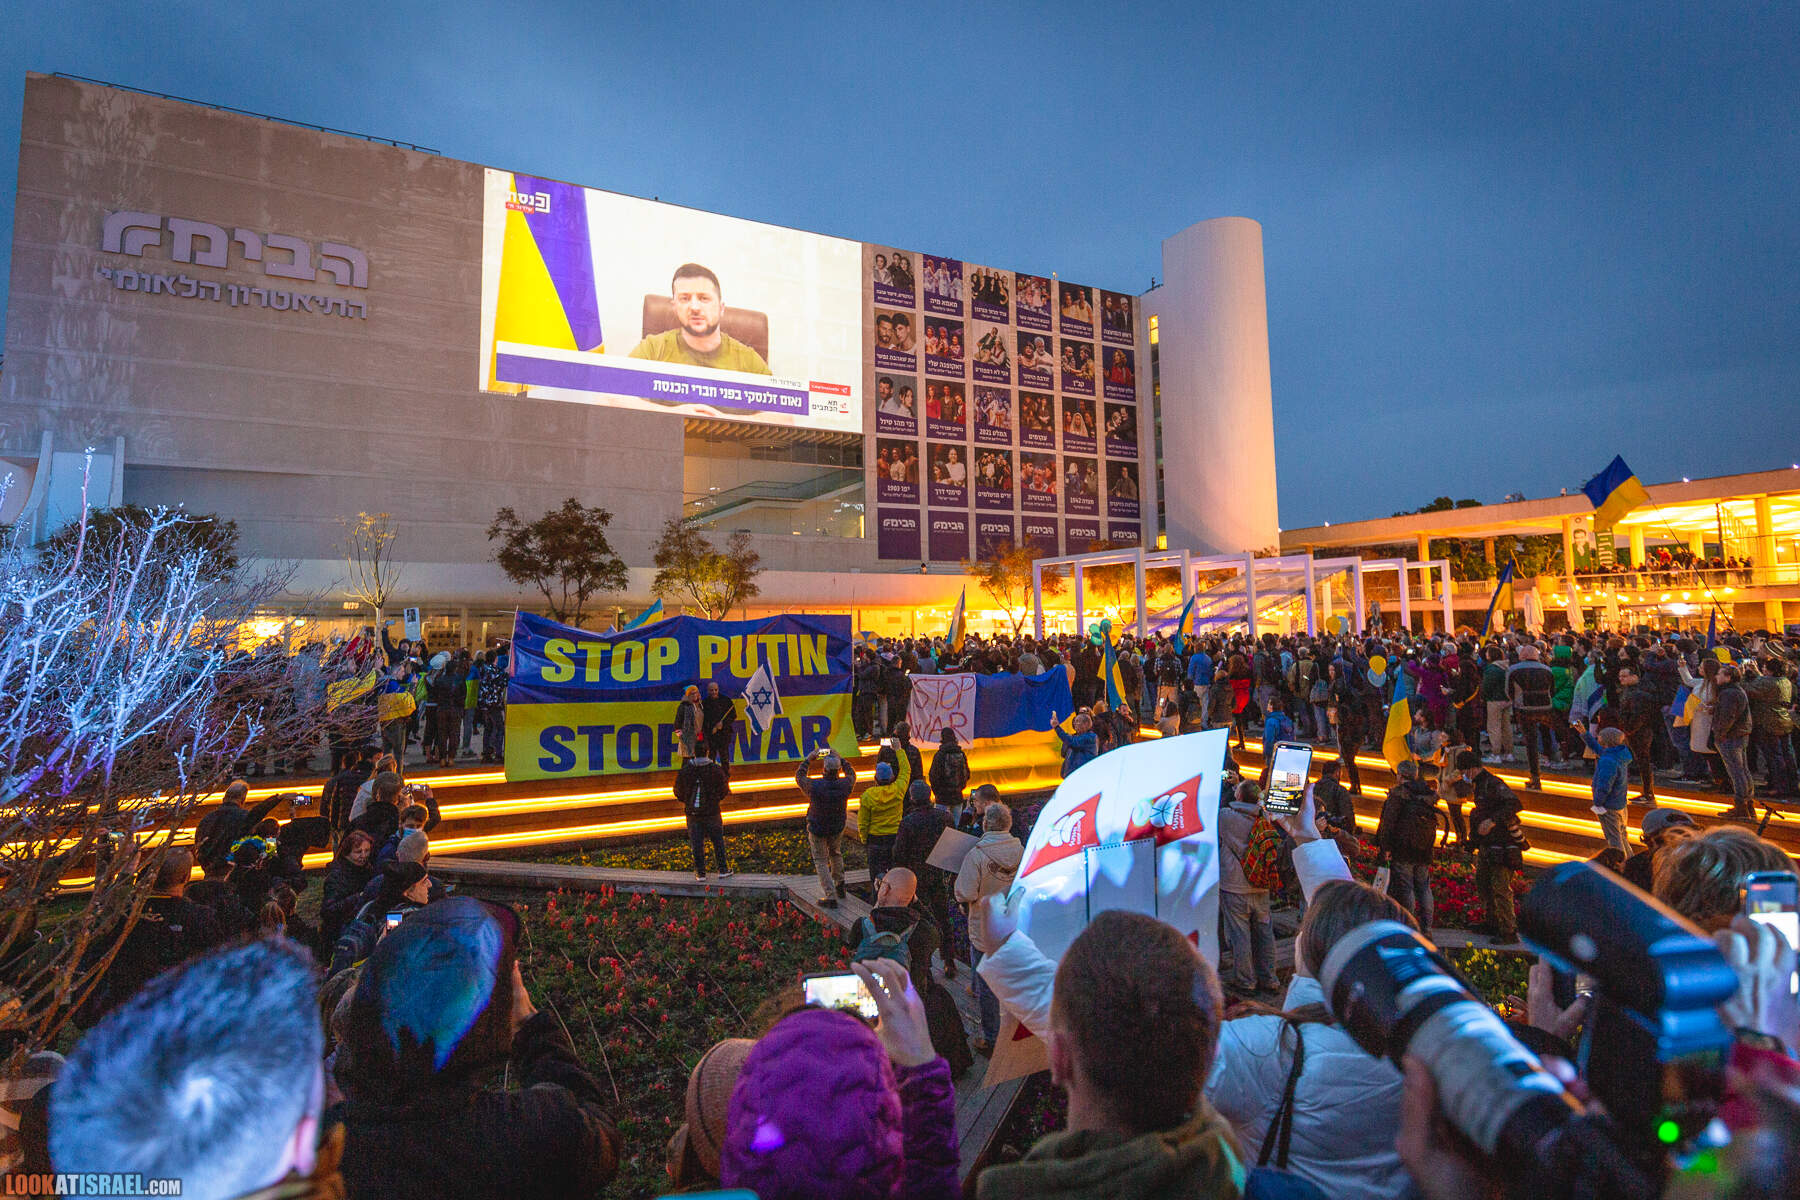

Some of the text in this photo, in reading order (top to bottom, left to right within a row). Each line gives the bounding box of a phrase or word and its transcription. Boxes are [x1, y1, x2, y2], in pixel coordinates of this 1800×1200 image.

[102, 210, 369, 288] הבימה
[101, 269, 367, 319] התיאטרון הלאומי
[653, 380, 802, 407] נאום זלנסקי בפני חברי הכנסת
[541, 634, 830, 683] STOP PUTIN
[913, 676, 975, 710] STOP
[908, 712, 970, 744] WAR
